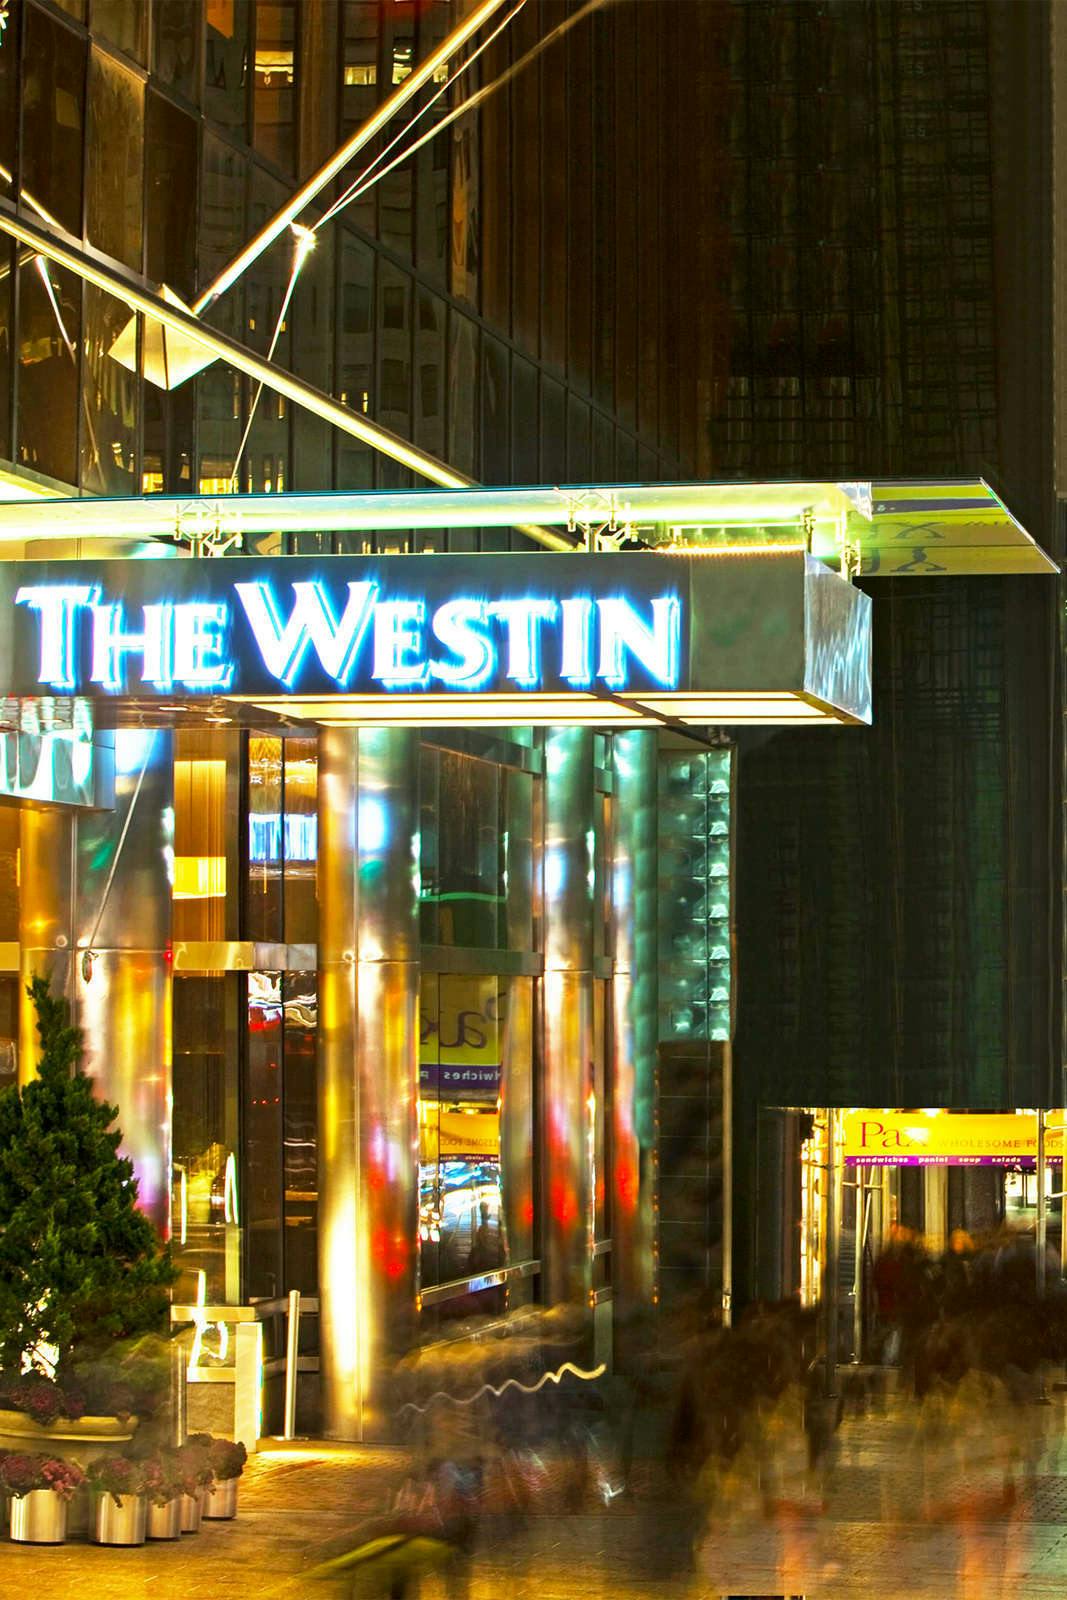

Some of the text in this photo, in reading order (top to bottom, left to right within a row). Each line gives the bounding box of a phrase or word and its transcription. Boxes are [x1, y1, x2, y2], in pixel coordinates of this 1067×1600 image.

[856, 1155, 909, 1164] sandwiches
[918, 1155, 948, 1165] panini
[992, 1155, 1021, 1164] salads
